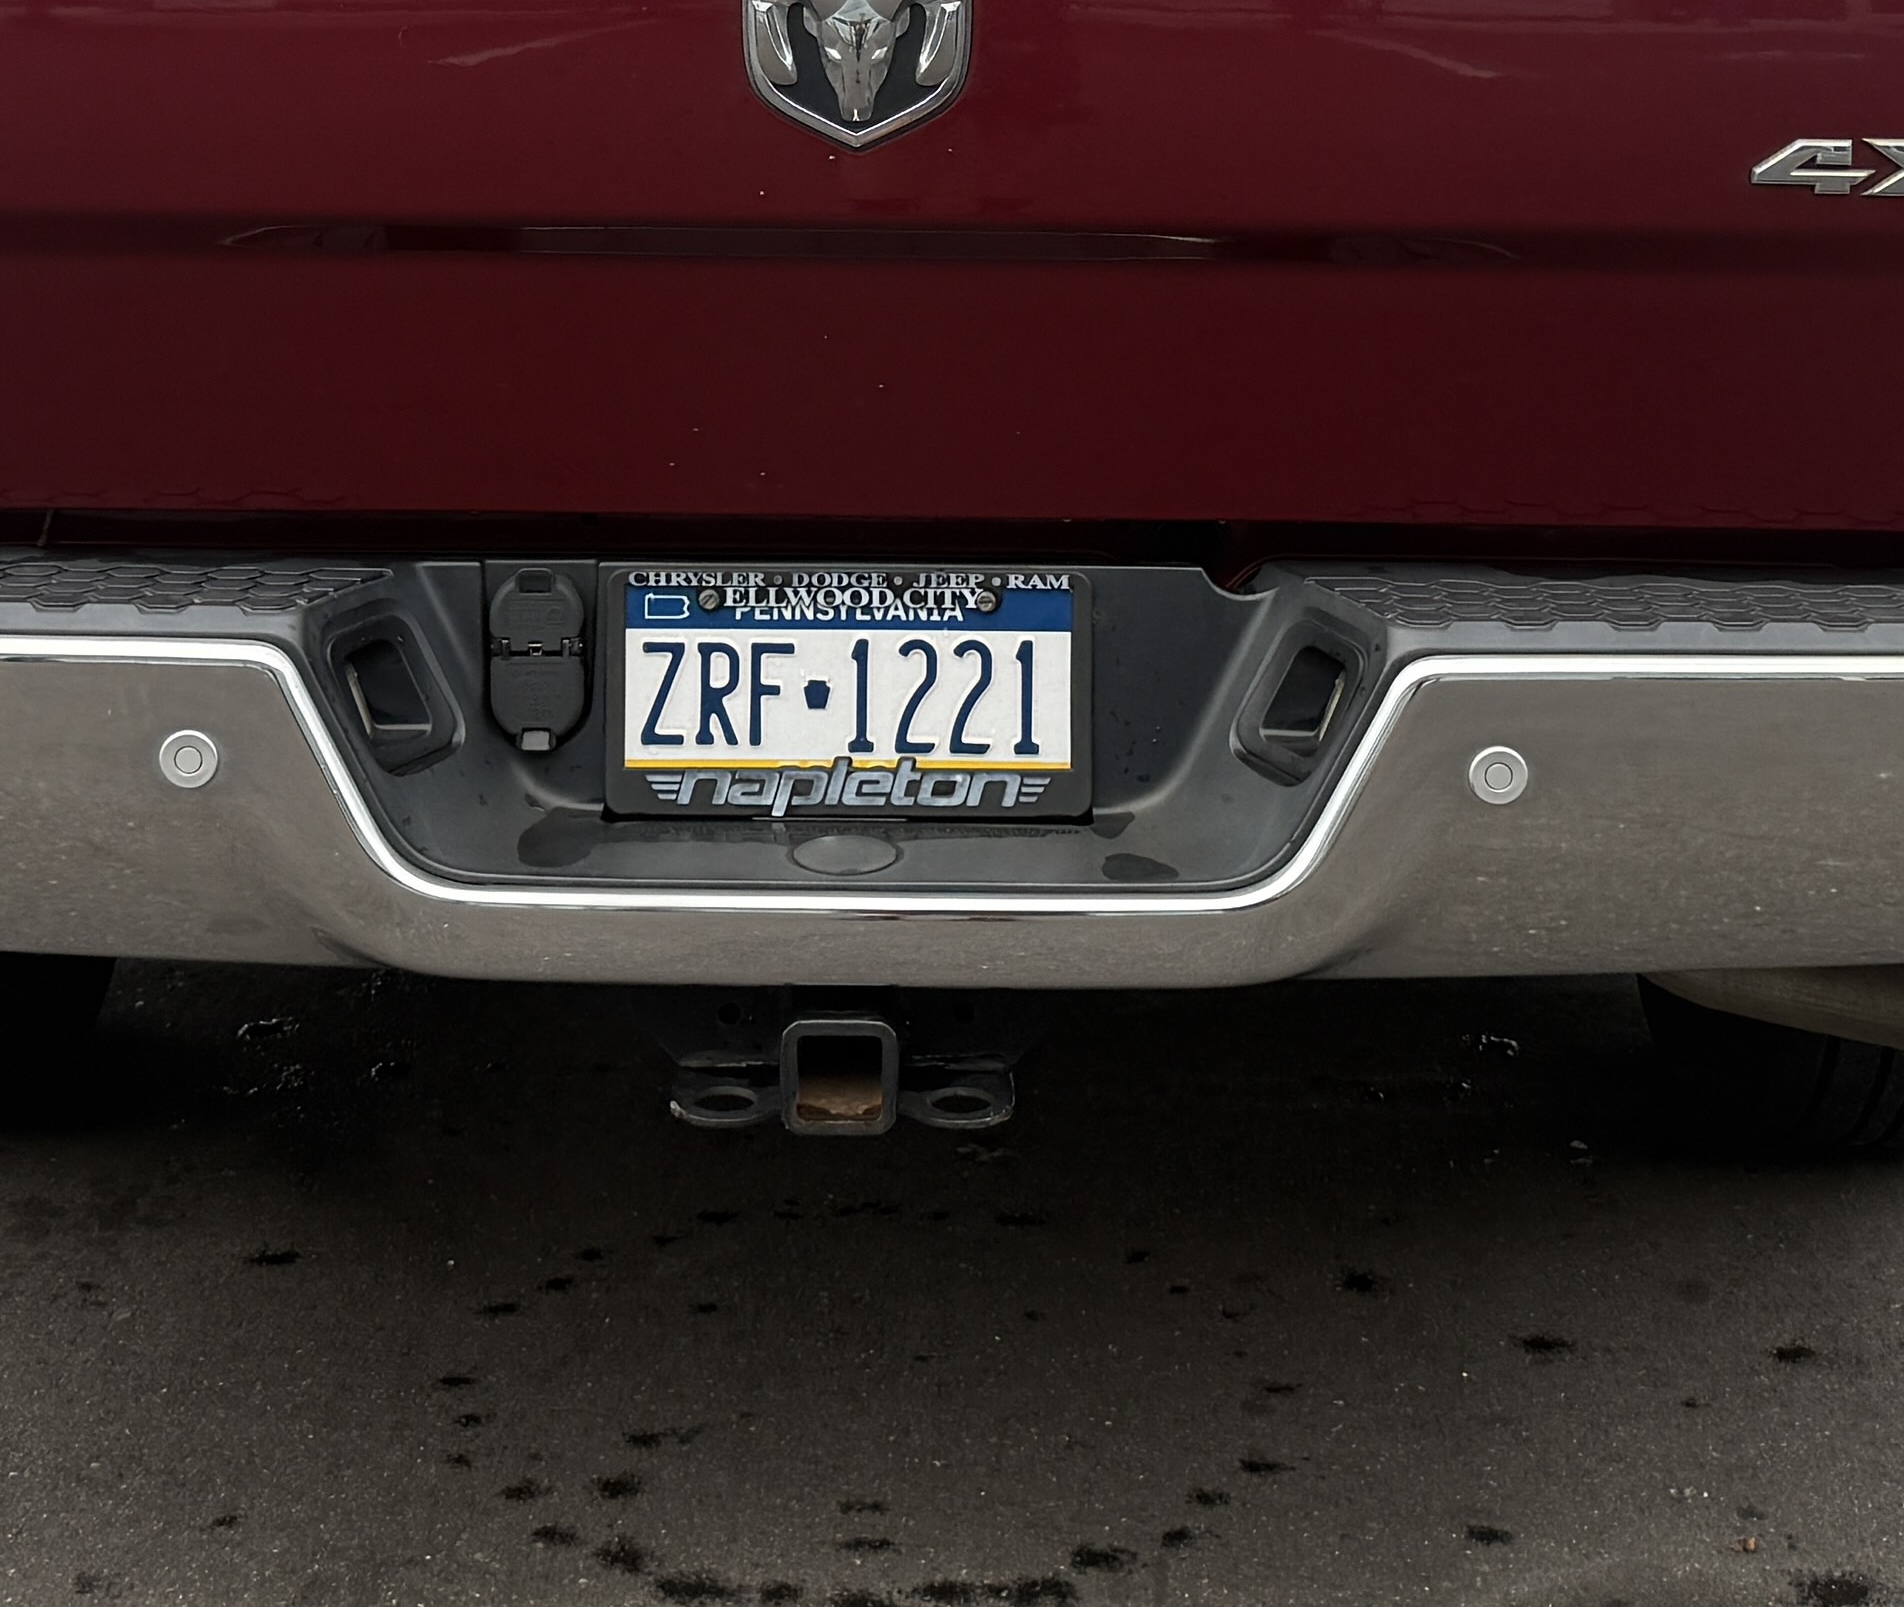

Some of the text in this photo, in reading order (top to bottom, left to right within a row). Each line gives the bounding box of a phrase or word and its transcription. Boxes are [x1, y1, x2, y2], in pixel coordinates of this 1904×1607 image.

[628, 571, 1071, 590] CHRYSLER DODGE JEEP RAM
[723, 587, 984, 609] ELLWOOD CITY
[640, 641, 796, 747] ZRF
[847, 638, 1041, 755] 1221
[676, 756, 1023, 817] napleton
